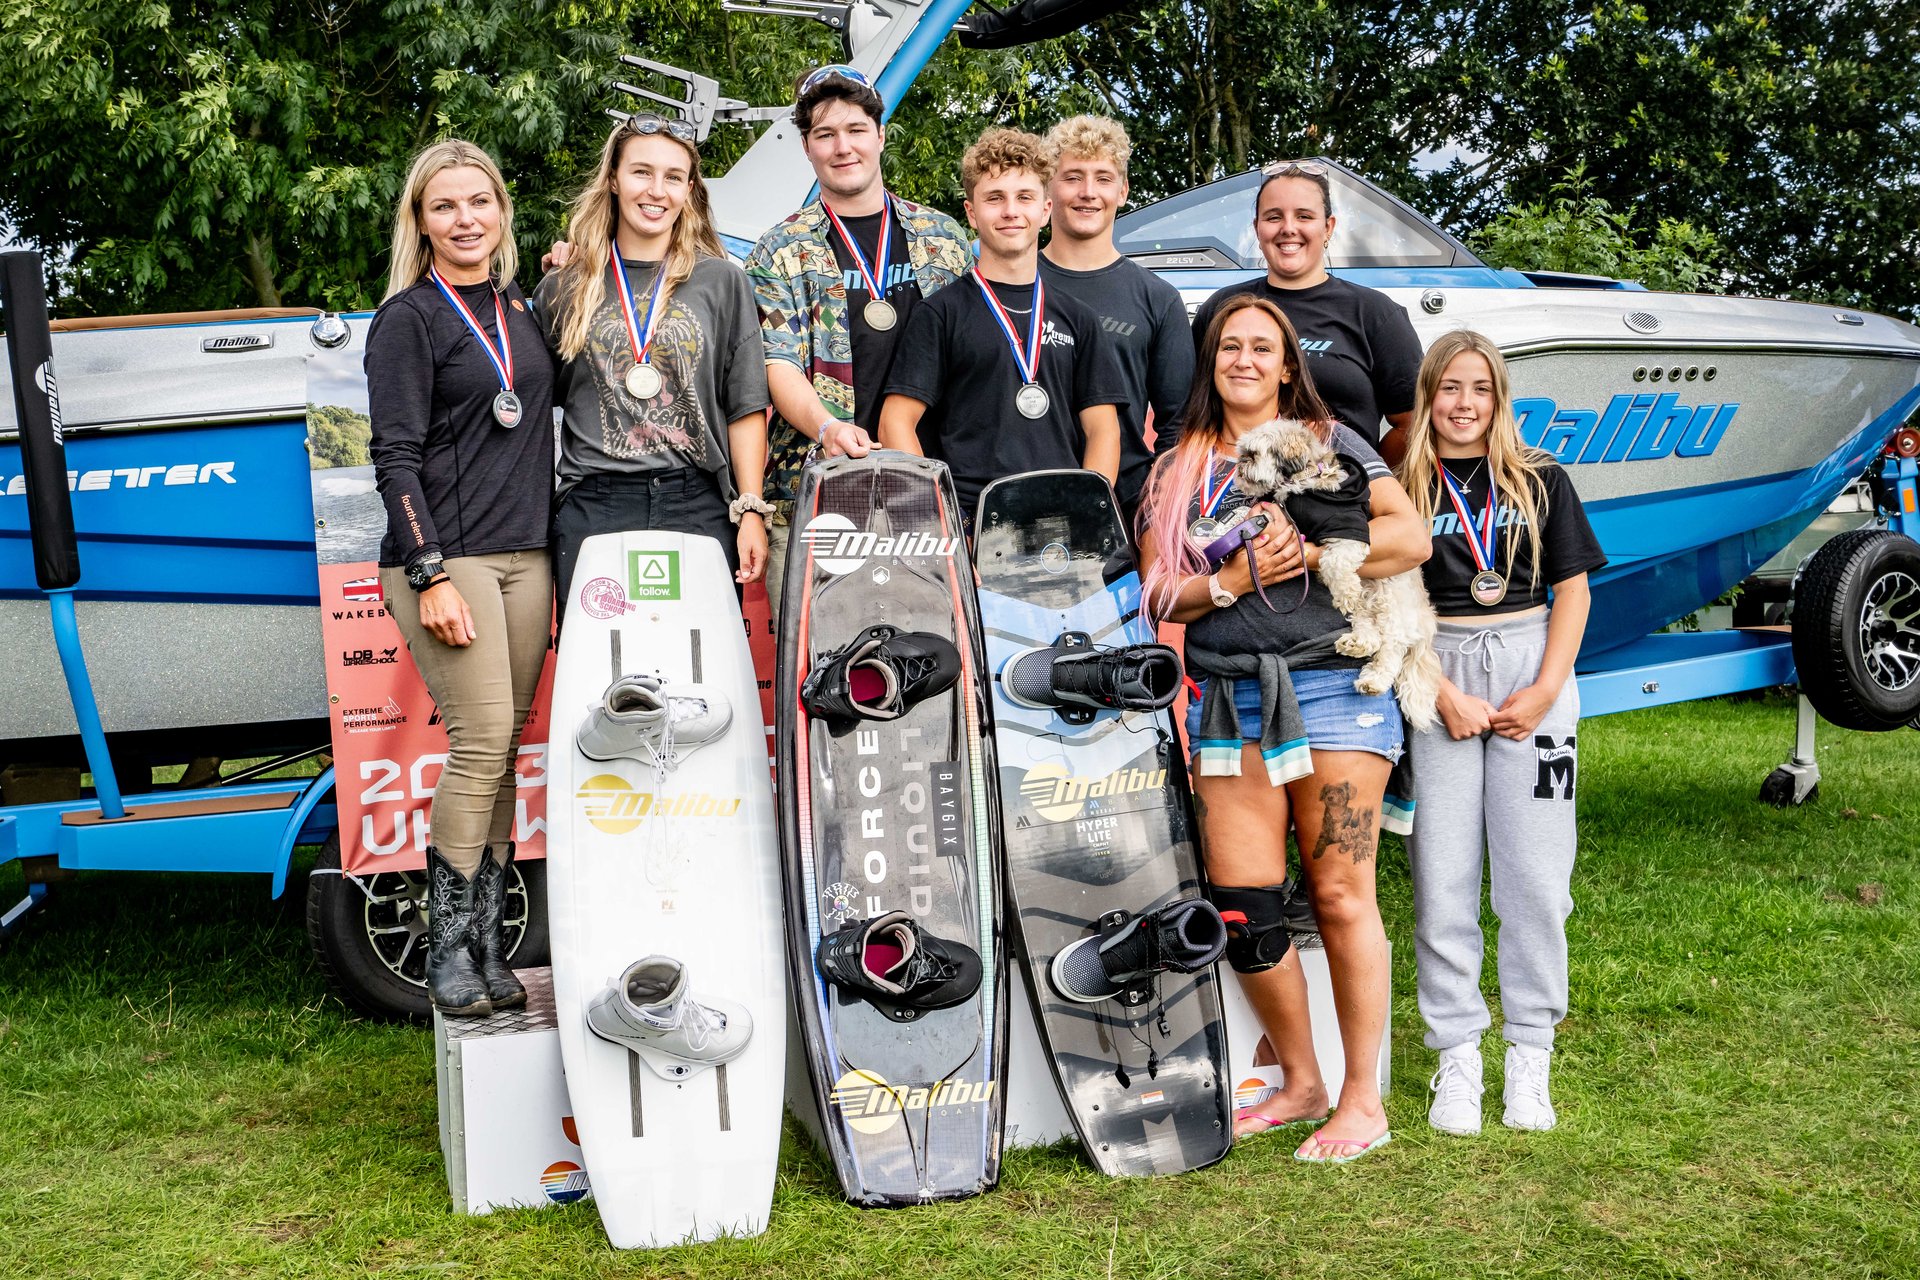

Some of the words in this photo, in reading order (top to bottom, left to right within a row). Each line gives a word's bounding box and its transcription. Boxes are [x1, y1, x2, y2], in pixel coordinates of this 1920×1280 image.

[212, 336, 260, 348] Malibu
[401, 494, 417, 521] fourth
[410, 521, 425, 547] eleme
[832, 532, 960, 557] Malibu
[333, 608, 391, 620] WAKEB
[343, 650, 373, 661] LDB
[343, 707, 383, 716] EXTREME
[343, 714, 377, 722] SPORTS
[343, 716, 408, 728] PERFORMANCE
[359, 743, 548, 806] 203
[1051, 767, 1167, 804] Malibu
[608, 792, 742, 817] Malibu
[856, 729, 889, 919] FORCE
[900, 727, 933, 917] LIQUID
[1076, 816, 1119, 833] HYPER
[1087, 829, 1112, 843] LITE
[865, 1078, 995, 1115] Malibu
